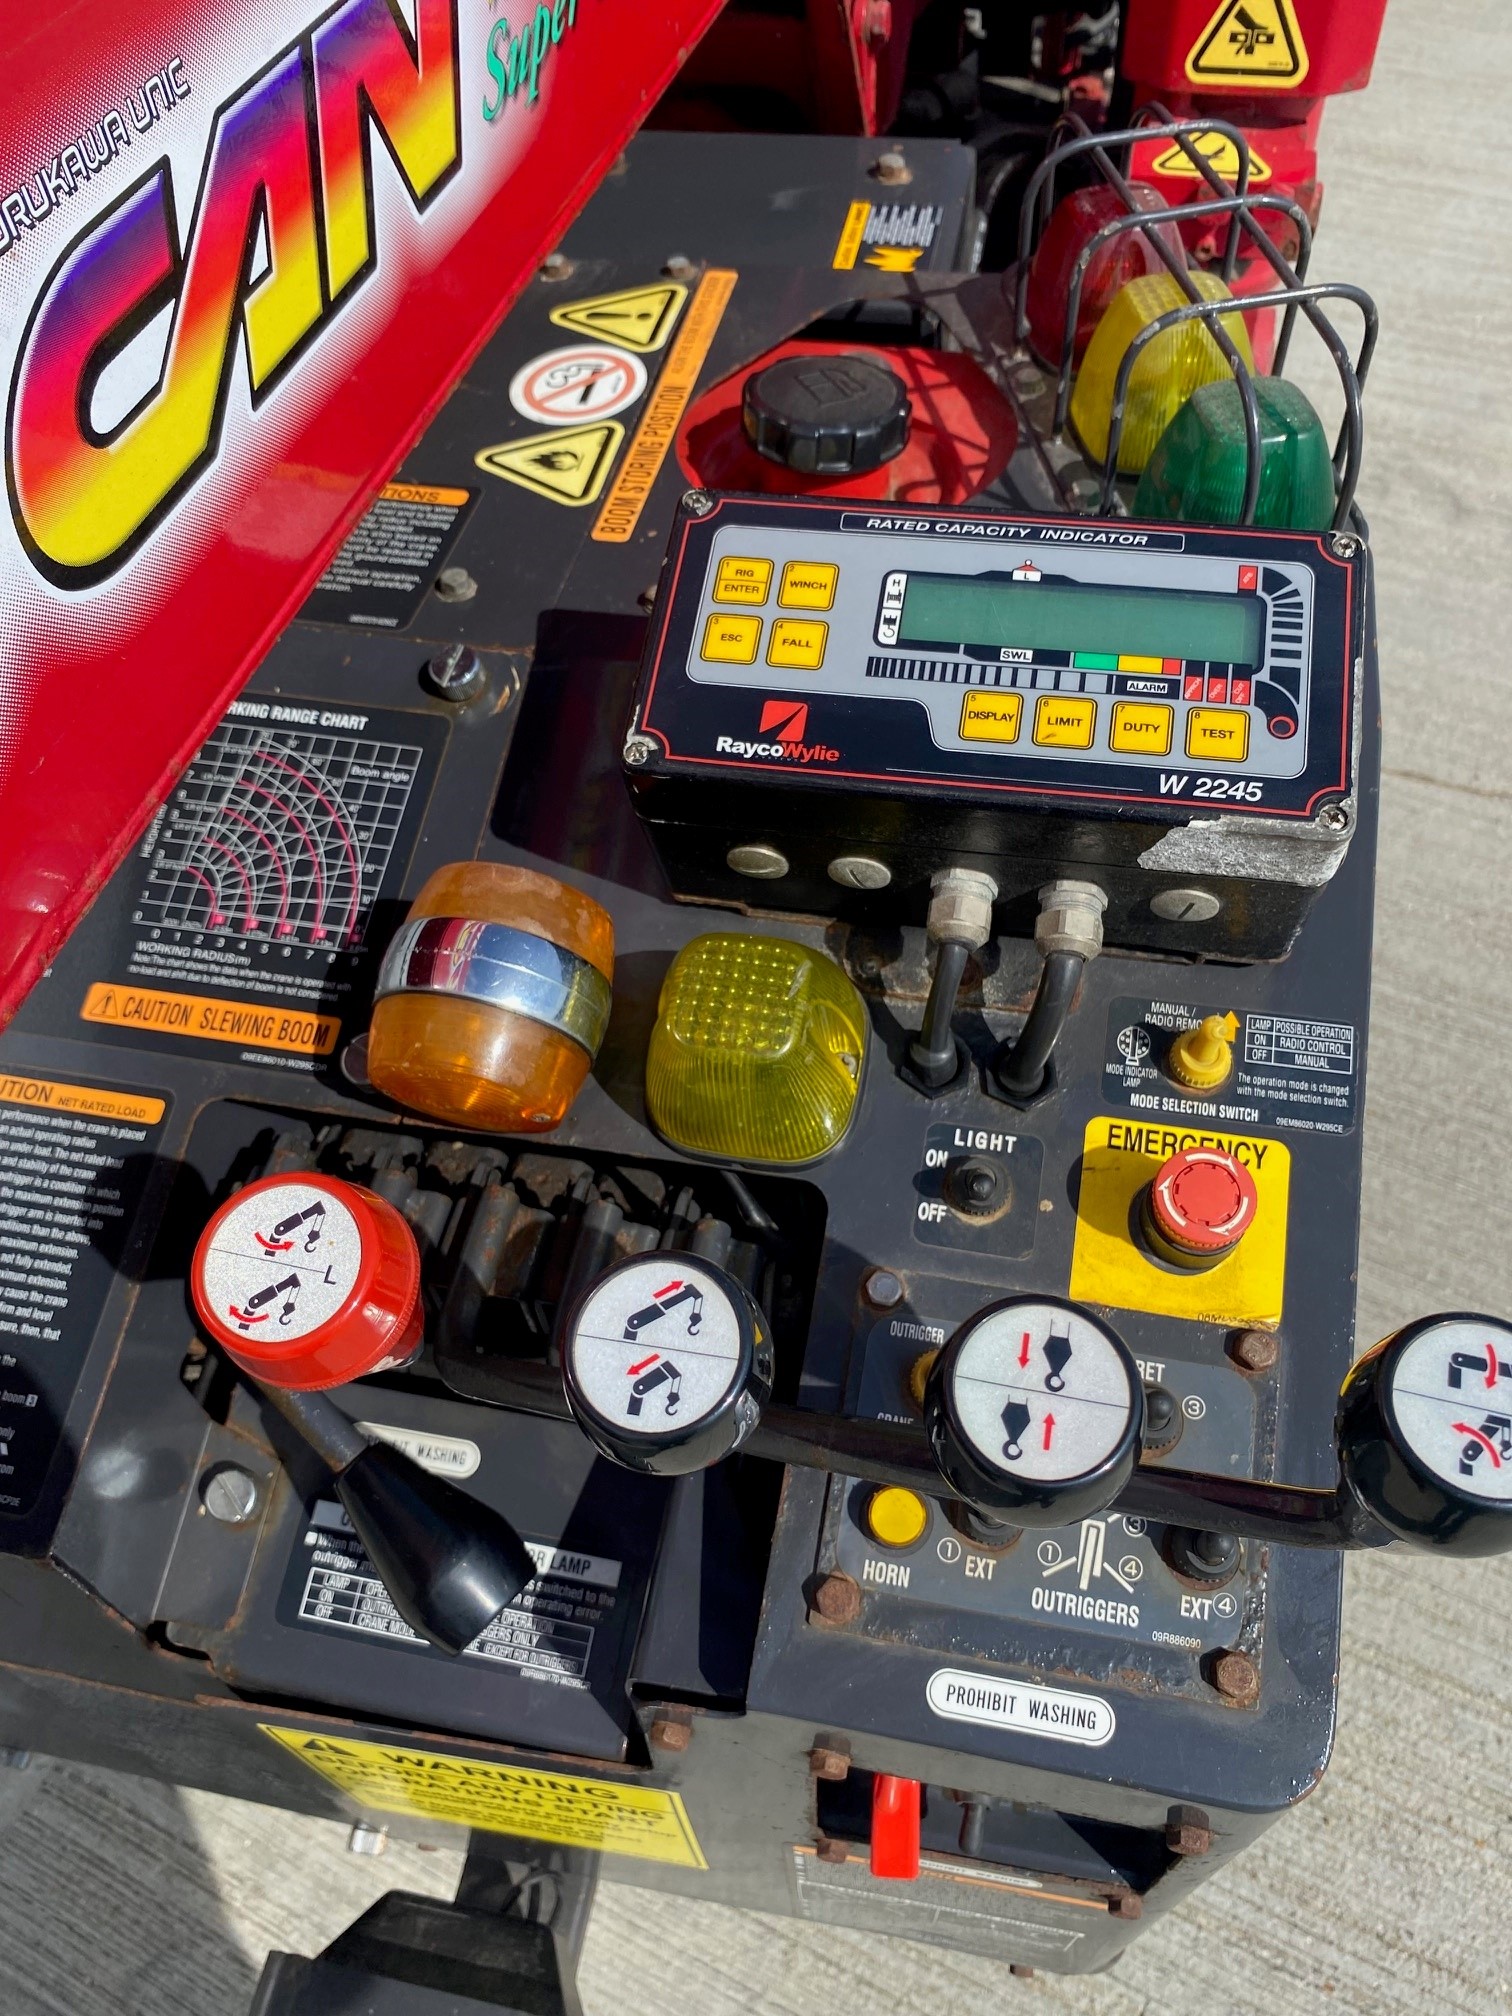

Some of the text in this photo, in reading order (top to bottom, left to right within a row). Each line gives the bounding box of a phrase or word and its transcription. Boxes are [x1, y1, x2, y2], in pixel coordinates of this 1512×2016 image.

[126, 56, 191, 134] UNIC
[4, 0, 464, 592] CAN
[600, 385, 688, 535] BOOM STORING POSITION
[383, 487, 440, 503] TIONS
[866, 518, 1149, 546] RATED CAPACITY INDICATOR
[735, 568, 754, 577] RIG
[724, 584, 760, 594] ENTER
[789, 581, 828, 590] WINCH
[720, 633, 742, 642] ESC
[781, 638, 813, 648] FALL
[1001, 650, 1031, 661] SWL
[970, 694, 976, 702] 5
[1128, 681, 1167, 693] ALARM
[227, 701, 369, 731] RKING RANGE CHART
[968, 710, 1015, 723] DISPLAY
[1047, 716, 1083, 727] LIMIT
[1194, 711, 1201, 719] 8
[1123, 722, 1160, 734] DUTY
[1201, 728, 1235, 740] TEST
[716, 736, 840, 763] RaycoWylie
[1158, 774, 1264, 802] W 2245
[136, 941, 252, 967] WORKING RADIUS(m)
[193, 934, 204, 945] 2
[215, 937, 226, 948] 3
[238, 940, 248, 951] 4
[259, 943, 270, 955] 5
[281, 946, 292, 958] 6
[304, 950, 315, 960] 7
[1150, 1001, 1190, 1016] MANUAL
[122, 996, 331, 1048] CAUTION SLEWING BOOM
[1144, 1013, 1204, 1030] RADIO REMO
[1251, 1018, 1351, 1041] LAMP POSSIBLE OPERATION
[1254, 1033, 1346, 1056] ON RADIO CONTROL
[1251, 1048, 1330, 1069] OFF MANUAL
[1105, 1063, 1158, 1080] MODE INDICATOR
[1122, 1076, 1141, 1088] LAMP
[1238, 1072, 1350, 1097] The operation mode is changed
[58, 1096, 79, 1108] NET
[80, 1099, 115, 1114] RATED
[117, 1104, 146, 1119] LOAD
[1130, 1093, 1259, 1122] MODE SELECTION SWITCH
[1236, 1085, 1349, 1108] with the mode selection switch.
[953, 1128, 1018, 1154] LIGHT
[925, 1148, 949, 1168] ON
[917, 1201, 947, 1223] OFF
[323, 1264, 337, 1286] L
[890, 1320, 945, 1344] OUTRIGGER
[1135, 1359, 1166, 1383] RET
[417, 1443, 468, 1465] WASHING
[550, 1554, 592, 1576] LAMP
[862, 1558, 911, 1589] HORN
[964, 1554, 997, 1581] EXT
[314, 1604, 334, 1619] OFF
[322, 1573, 556, 1635] LAMP OPERATION
[1031, 1586, 1140, 1629] OUTRIGGERS
[1180, 1593, 1213, 1621] EXT
[318, 1588, 540, 1648] ON ONLY
[1152, 1630, 1201, 1649] 09R886090
[945, 1683, 1097, 1730] PROHIBIT WASHING
[379, 1751, 620, 1800] WARNING
